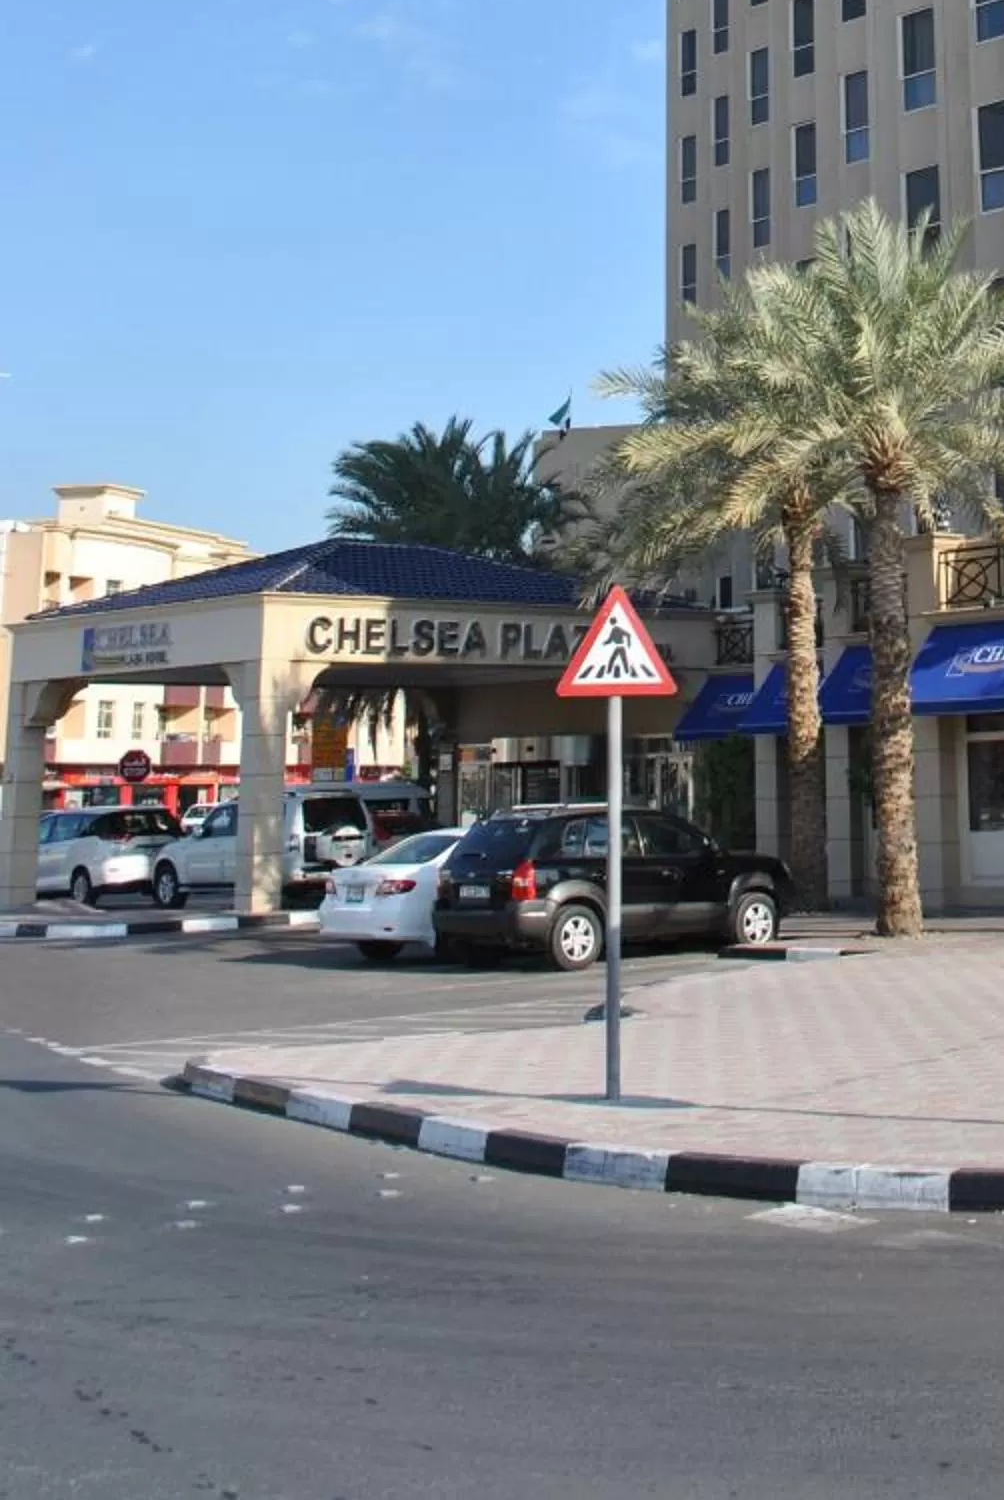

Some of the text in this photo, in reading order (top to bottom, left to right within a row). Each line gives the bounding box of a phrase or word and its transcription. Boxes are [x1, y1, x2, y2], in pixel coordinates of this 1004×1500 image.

[93, 622, 174, 654] CHELSEA
[305, 616, 592, 661] CHELSEA PLAZ
